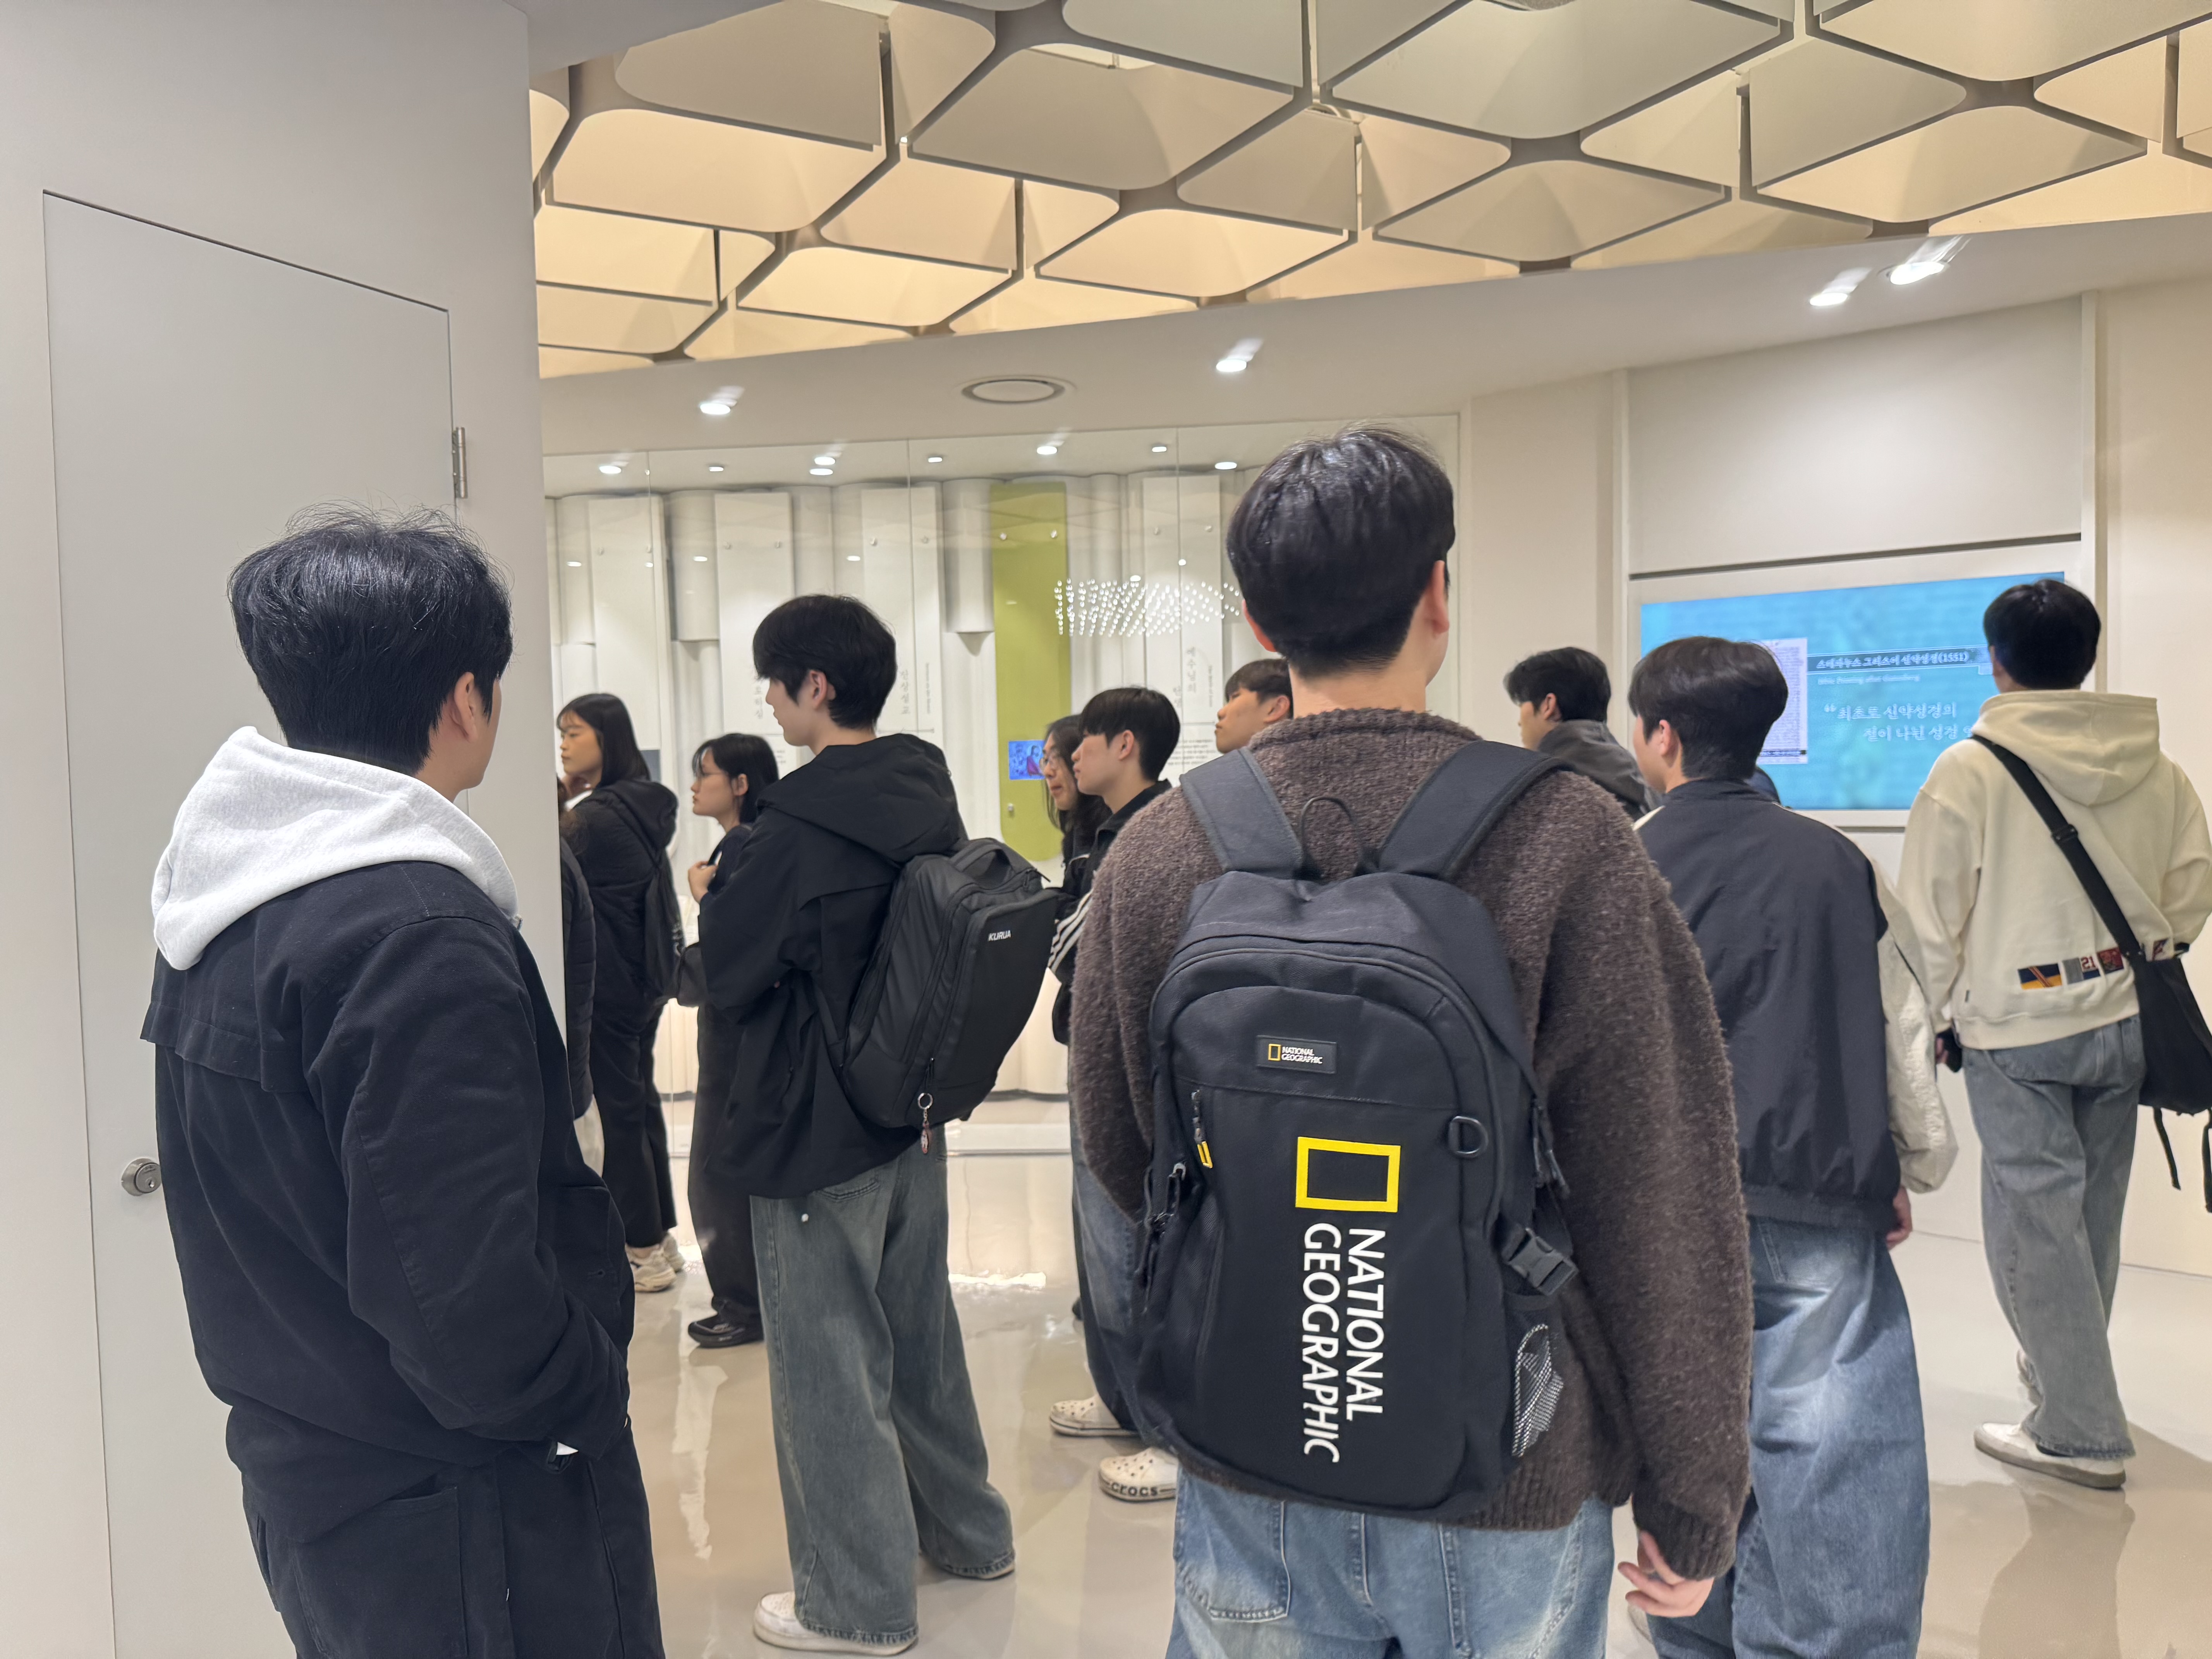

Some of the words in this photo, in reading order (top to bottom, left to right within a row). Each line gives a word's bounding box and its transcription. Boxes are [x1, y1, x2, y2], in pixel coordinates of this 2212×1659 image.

[1883, 701, 1957, 720] 신약성경의
[1863, 725, 1892, 742] 절이
[1929, 723, 1958, 740] 성경
[1281, 1053, 1323, 1064] GEOGRAPHIC
[1282, 1046, 1315, 1056] NATIONAL
[1346, 1228, 1386, 1421] NATIONAL
[1302, 1223, 1342, 1463] GEOGRAPHIC
[1111, 1482, 1158, 1498] crocs
